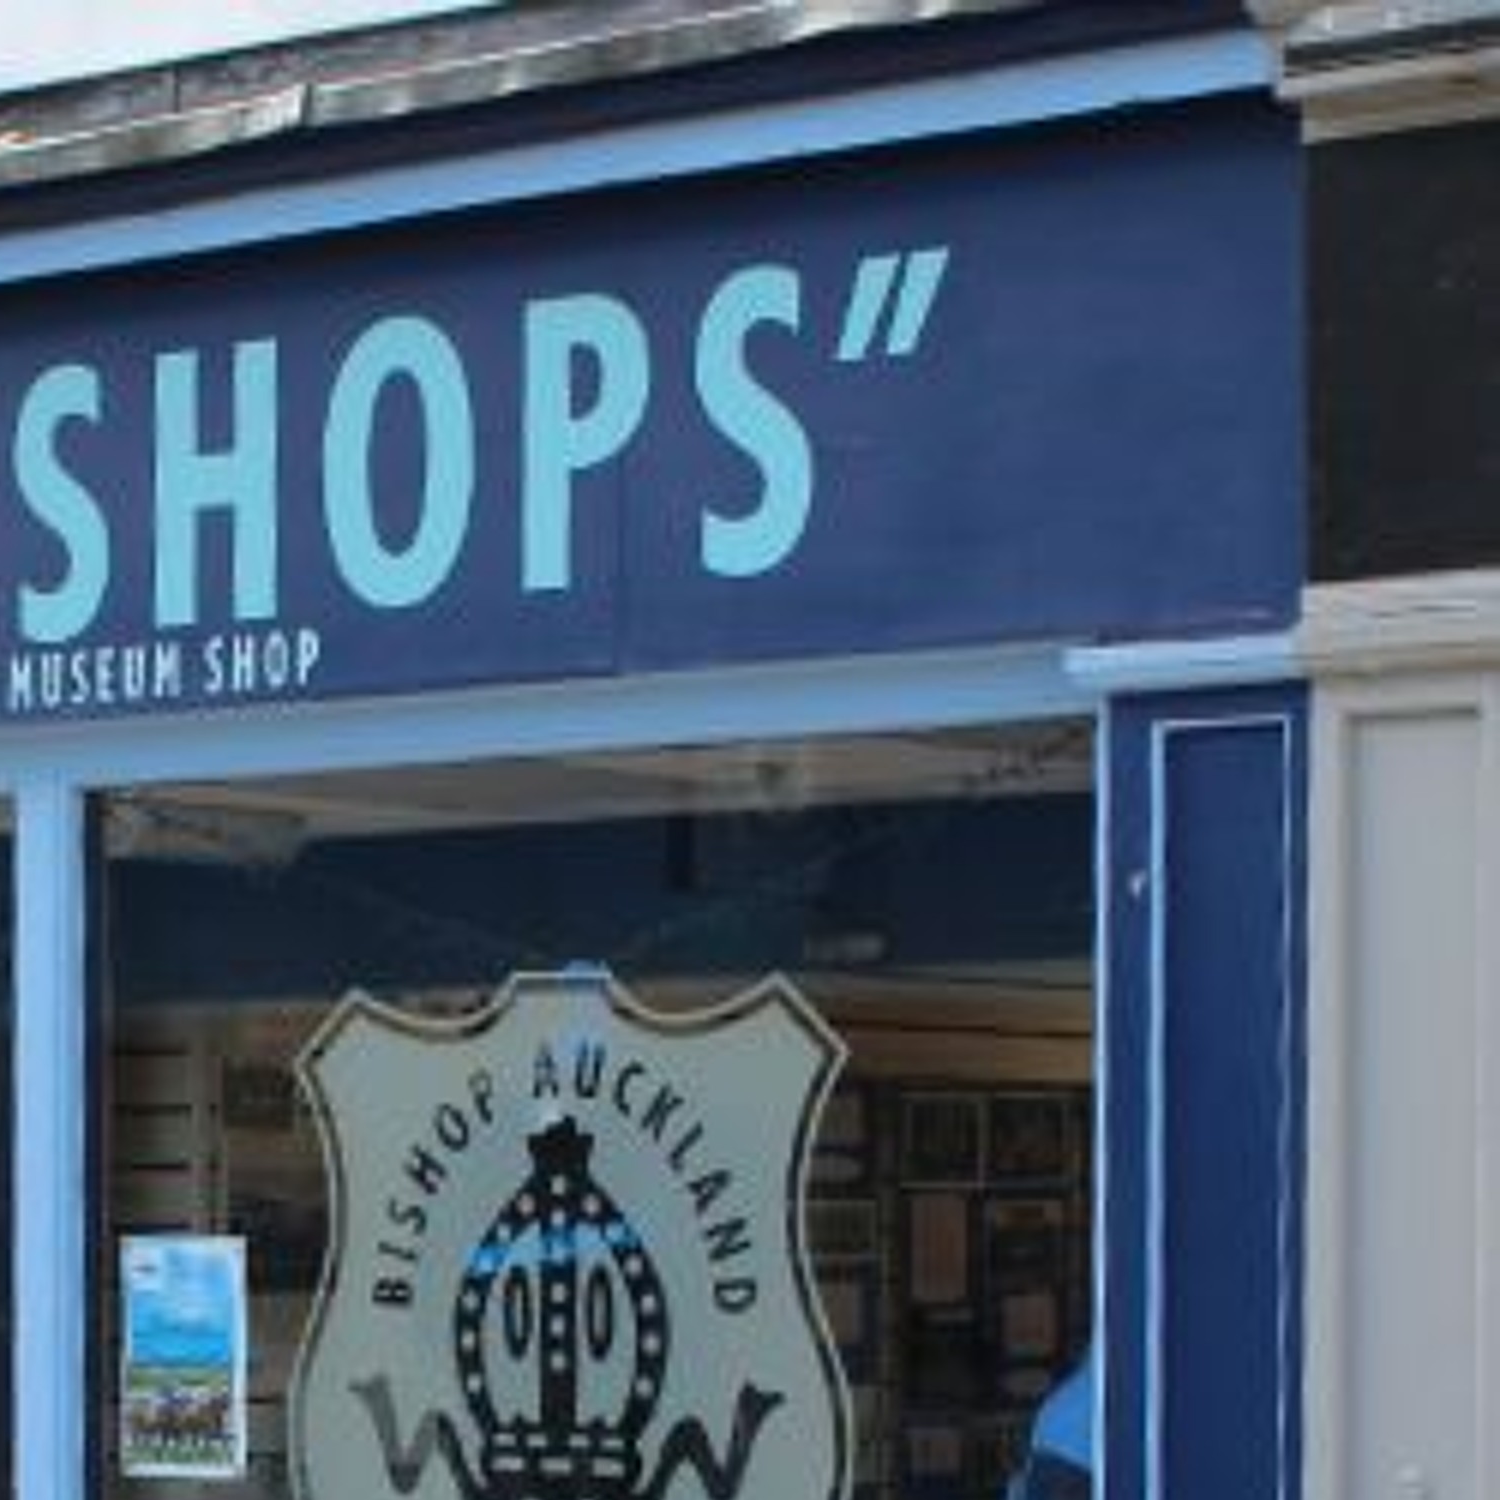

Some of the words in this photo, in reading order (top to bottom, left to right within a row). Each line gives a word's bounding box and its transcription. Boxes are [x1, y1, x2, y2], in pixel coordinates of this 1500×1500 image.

[7, 641, 183, 711] MUSEUM
[203, 629, 322, 695] SHOP
[372, 1068, 495, 1308] BISHOP
[532, 1040, 758, 1315] AUCKLAND
